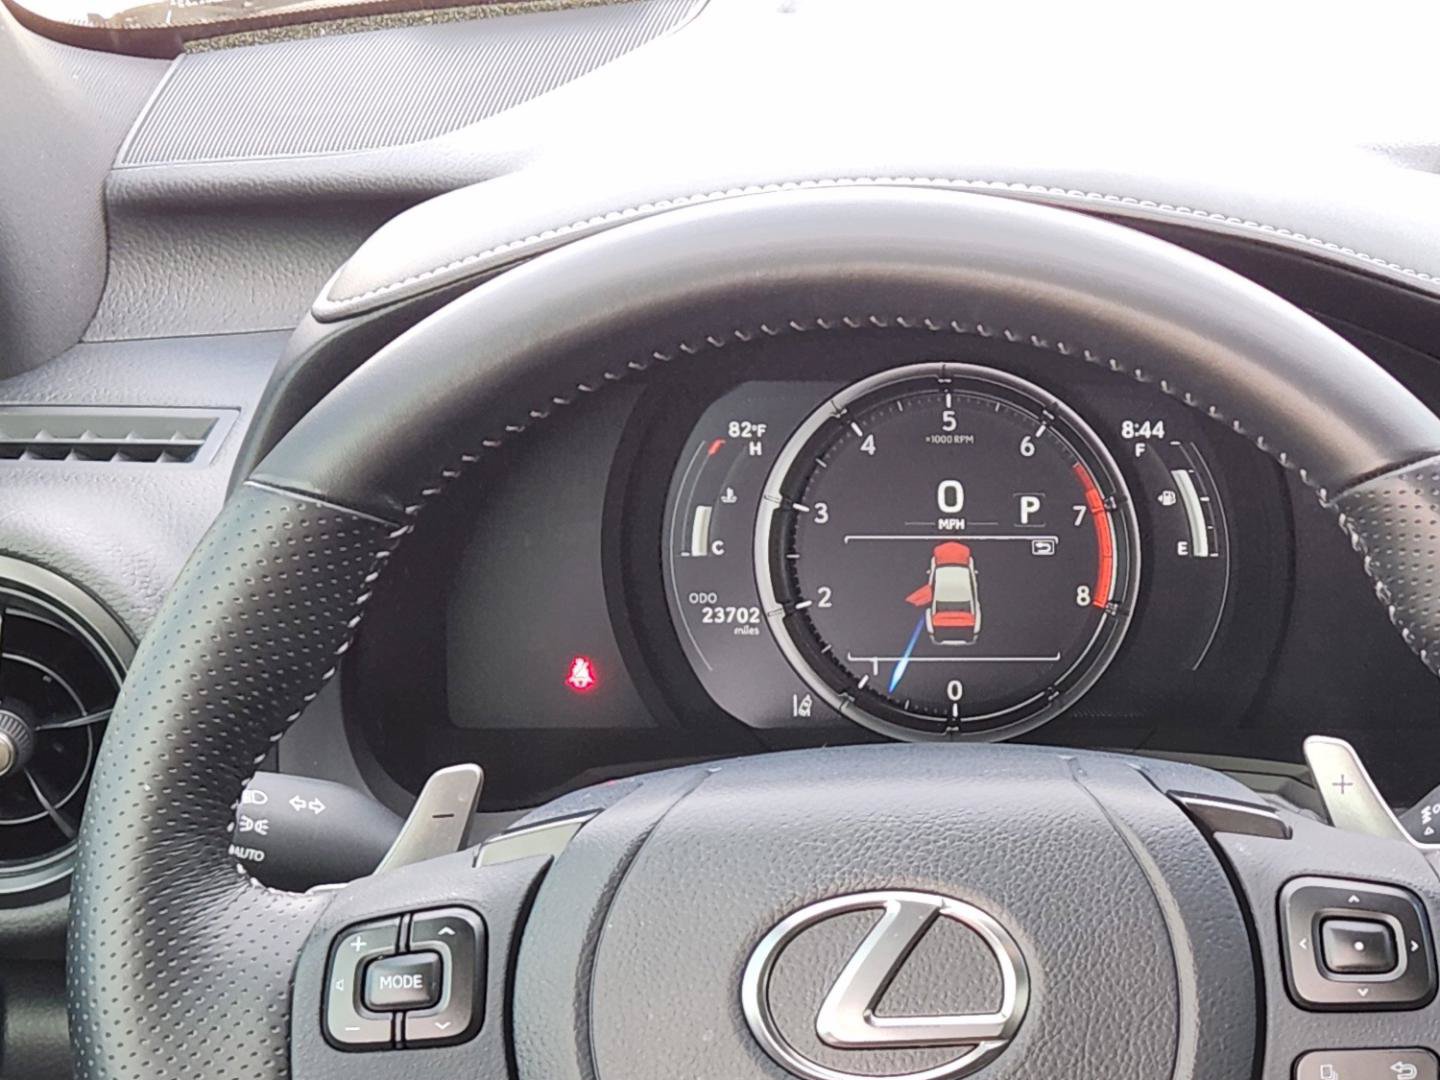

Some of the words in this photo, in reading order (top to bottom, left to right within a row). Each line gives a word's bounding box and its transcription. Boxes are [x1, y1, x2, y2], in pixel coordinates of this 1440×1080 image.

[942, 410, 957, 431] 5
[1121, 421, 1166, 439] 8:44
[749, 441, 762, 456] H
[860, 435, 876, 455] 4
[953, 435, 974, 445] RPM
[1020, 437, 1035, 457] 6
[1135, 443, 1146, 457] F
[937, 480, 964, 513] 0
[814, 503, 829, 524] 3
[1020, 496, 1041, 524] P
[1073, 506, 1087, 526] 7
[938, 518, 966, 531] MPH
[711, 540, 725, 555] C
[1177, 542, 1188, 557] E
[688, 592, 717, 604] ODO
[818, 587, 833, 607] 2
[1076, 586, 1091, 606] 8
[701, 607, 760, 624] 23702
[734, 626, 760, 636] miles
[947, 680, 963, 700] 0
[380, 974, 423, 990] MODE
